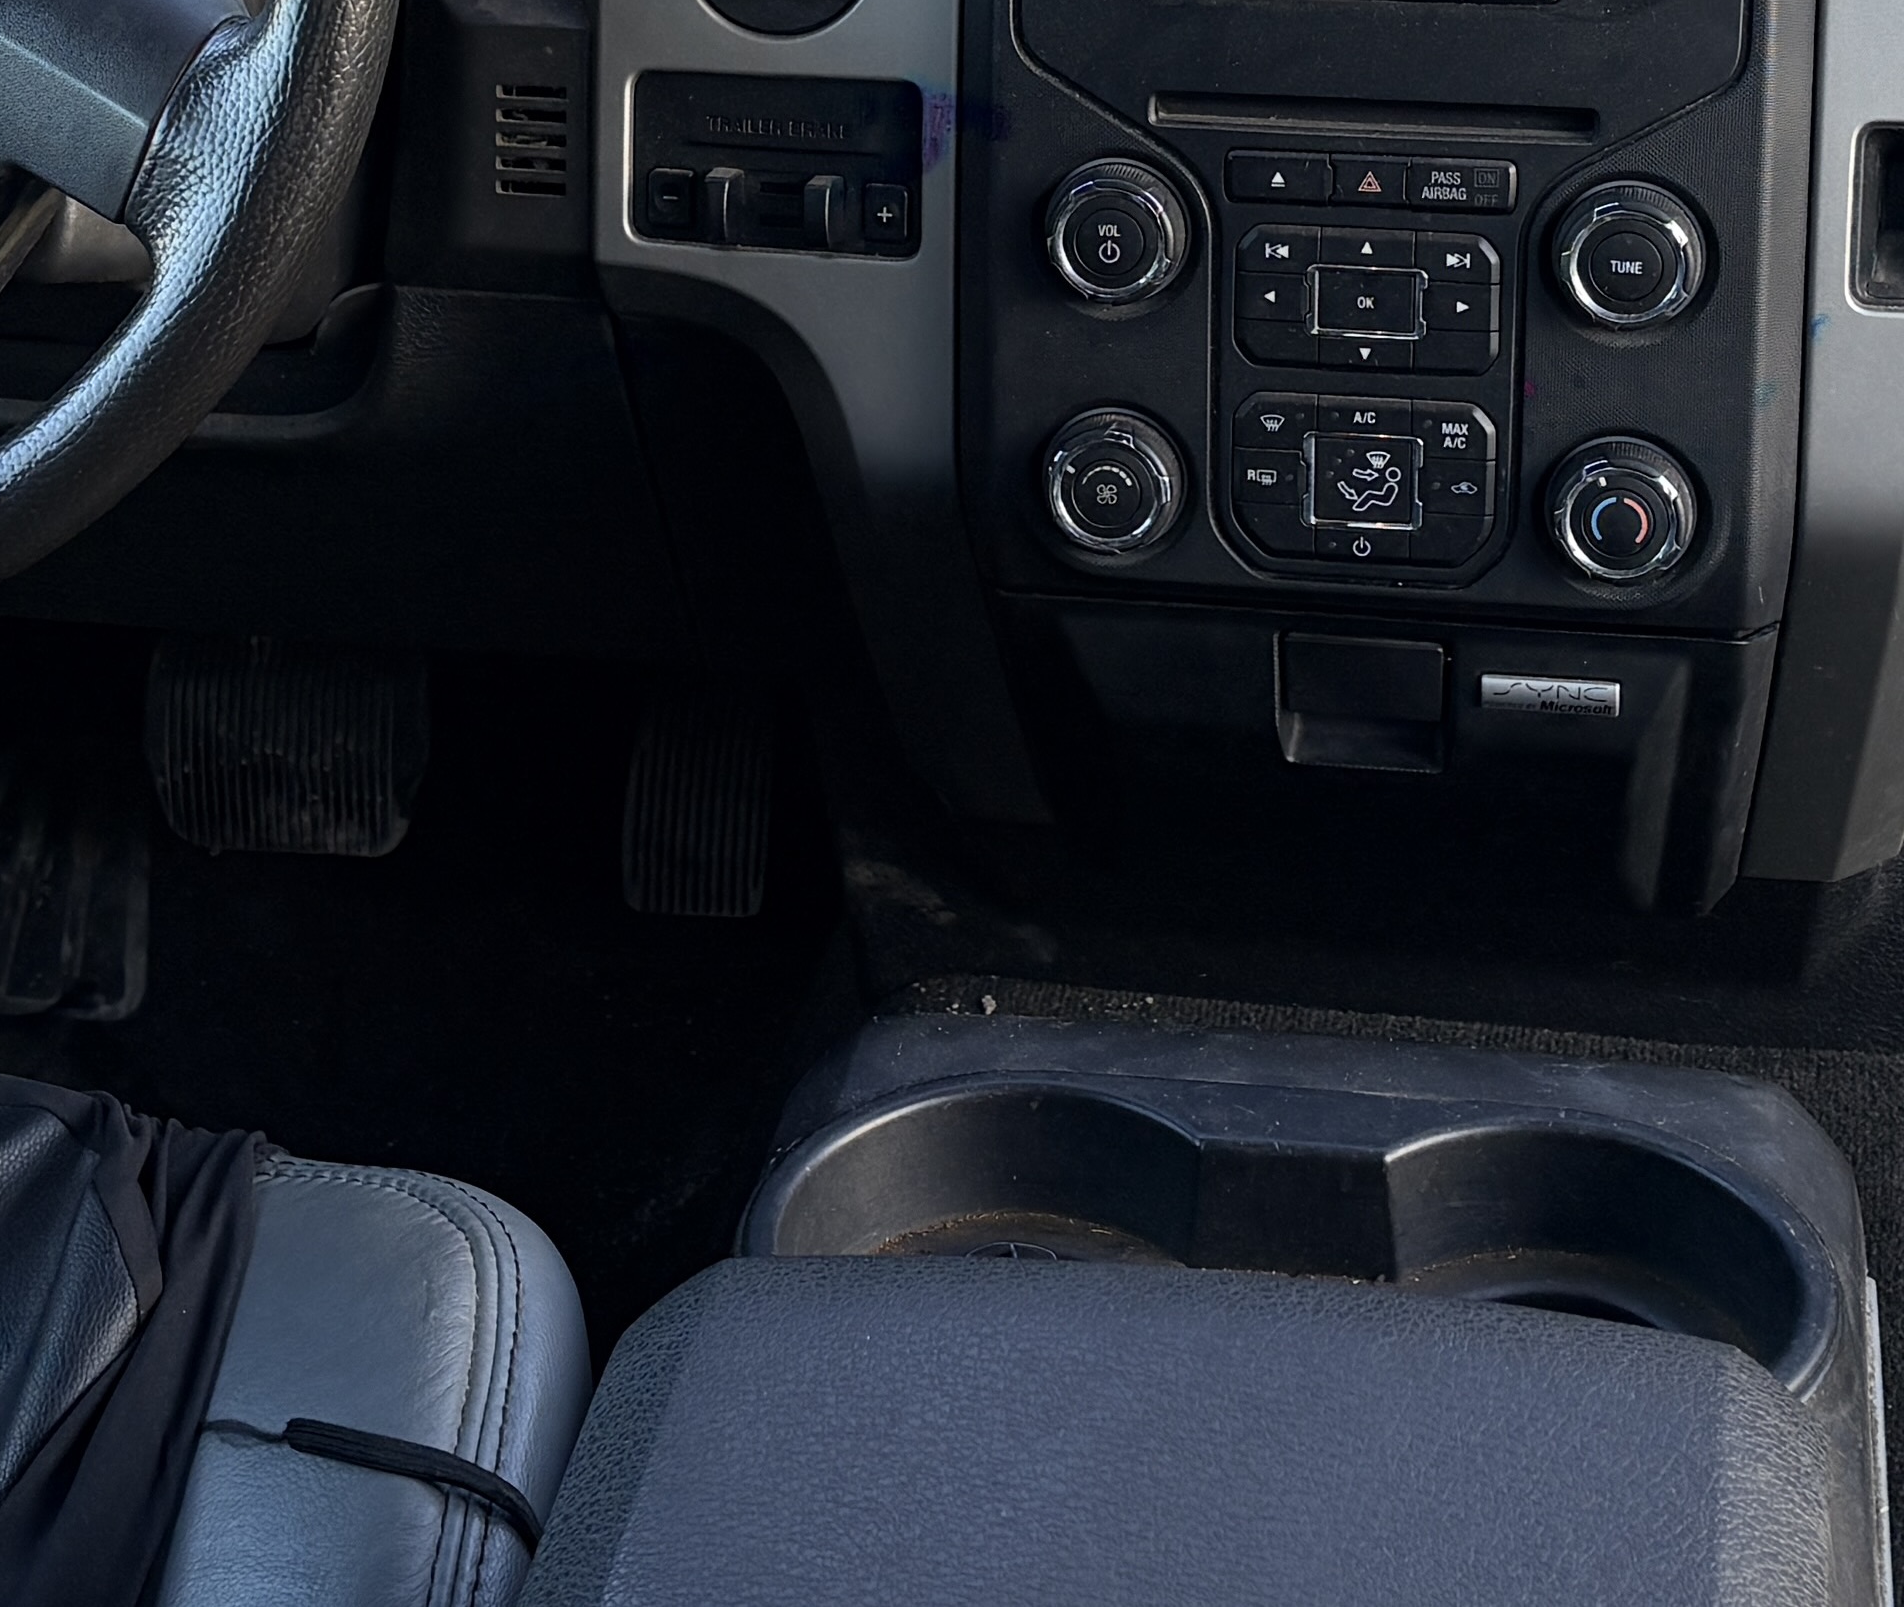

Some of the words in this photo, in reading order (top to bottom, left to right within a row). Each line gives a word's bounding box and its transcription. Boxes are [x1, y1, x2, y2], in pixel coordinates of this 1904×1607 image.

[705, 115, 784, 137] TRAILER
[1431, 171, 1461, 185] PASS
[1421, 186, 1467, 201] AIRBAG
[1098, 224, 1121, 237] VOL
[1610, 260, 1643, 274] TUNE
[1357, 296, 1375, 309] OK
[1353, 411, 1377, 424] A/C
[1441, 423, 1469, 436] MAX
[1443, 436, 1467, 450] A/C
[1493, 682, 1609, 703] SYNC
[1539, 700, 1614, 715] Microsoft
